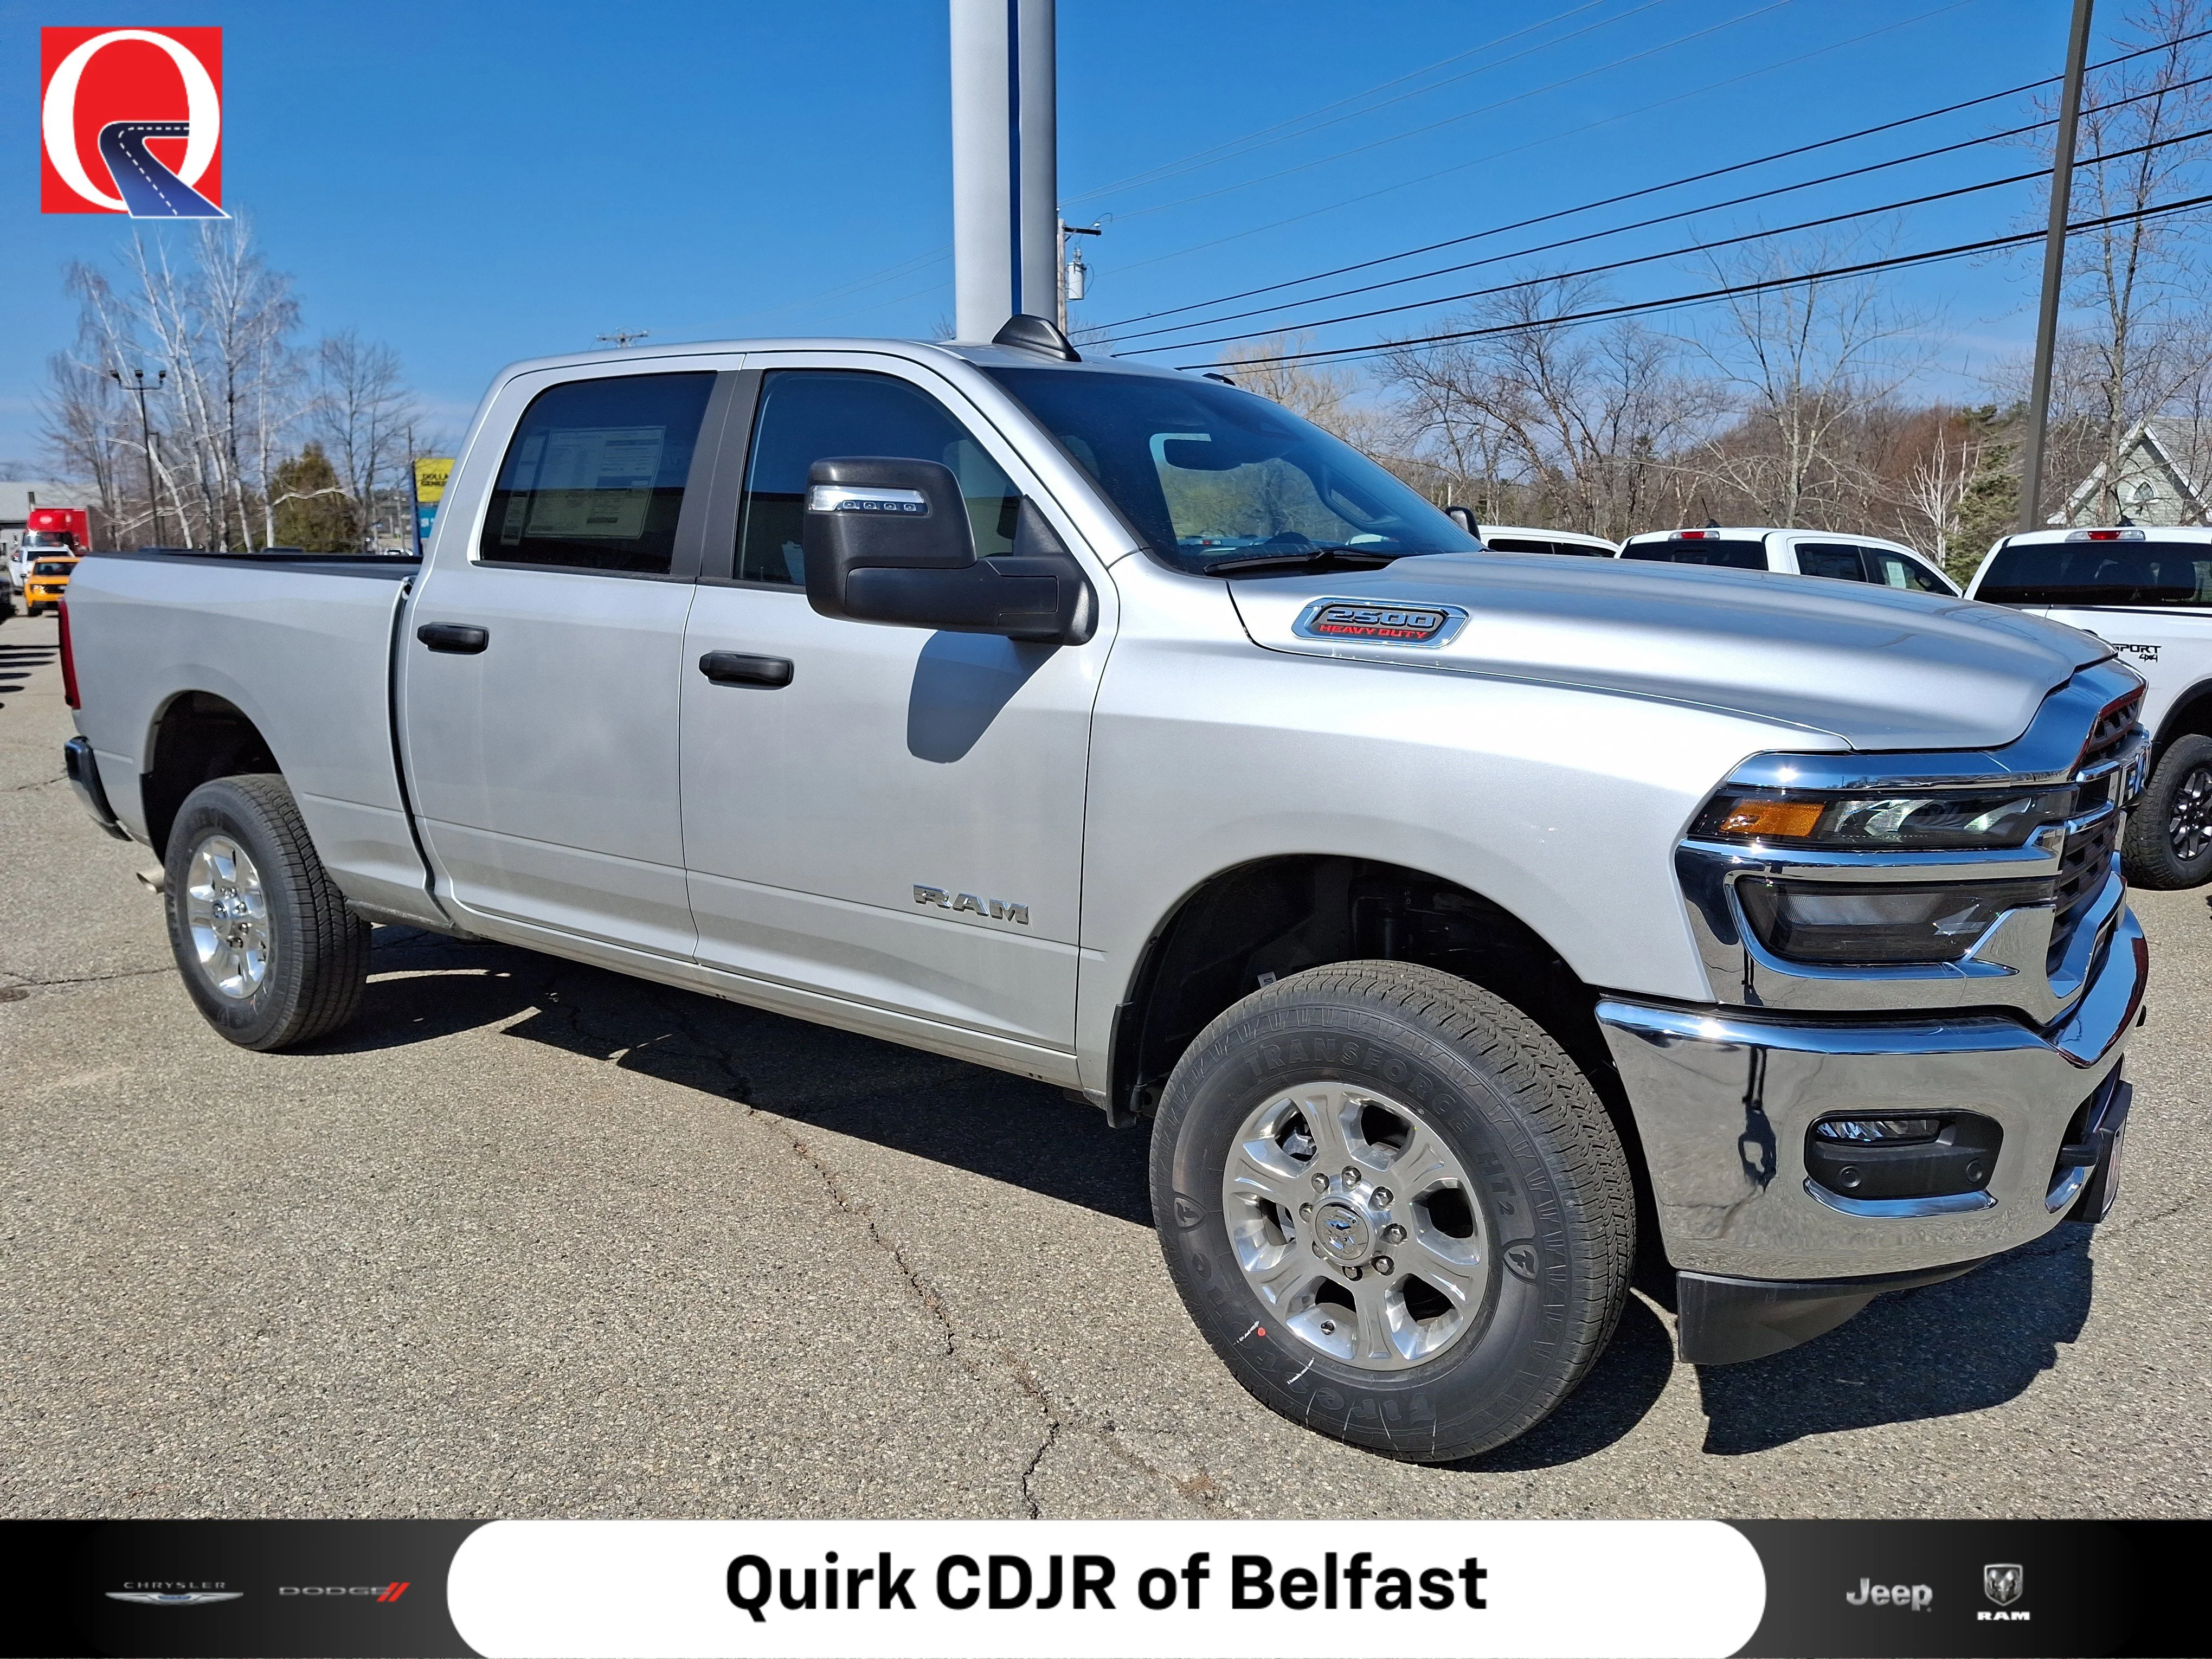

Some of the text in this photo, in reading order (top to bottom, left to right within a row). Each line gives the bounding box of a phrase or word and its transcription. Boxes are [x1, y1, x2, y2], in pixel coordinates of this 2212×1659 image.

[1319, 624, 1427, 639] HEAVY DUTY
[1327, 609, 1436, 629] 2500
[913, 884, 1029, 925] RAM
[1245, 1038, 1475, 1133] TRANSFORCE
